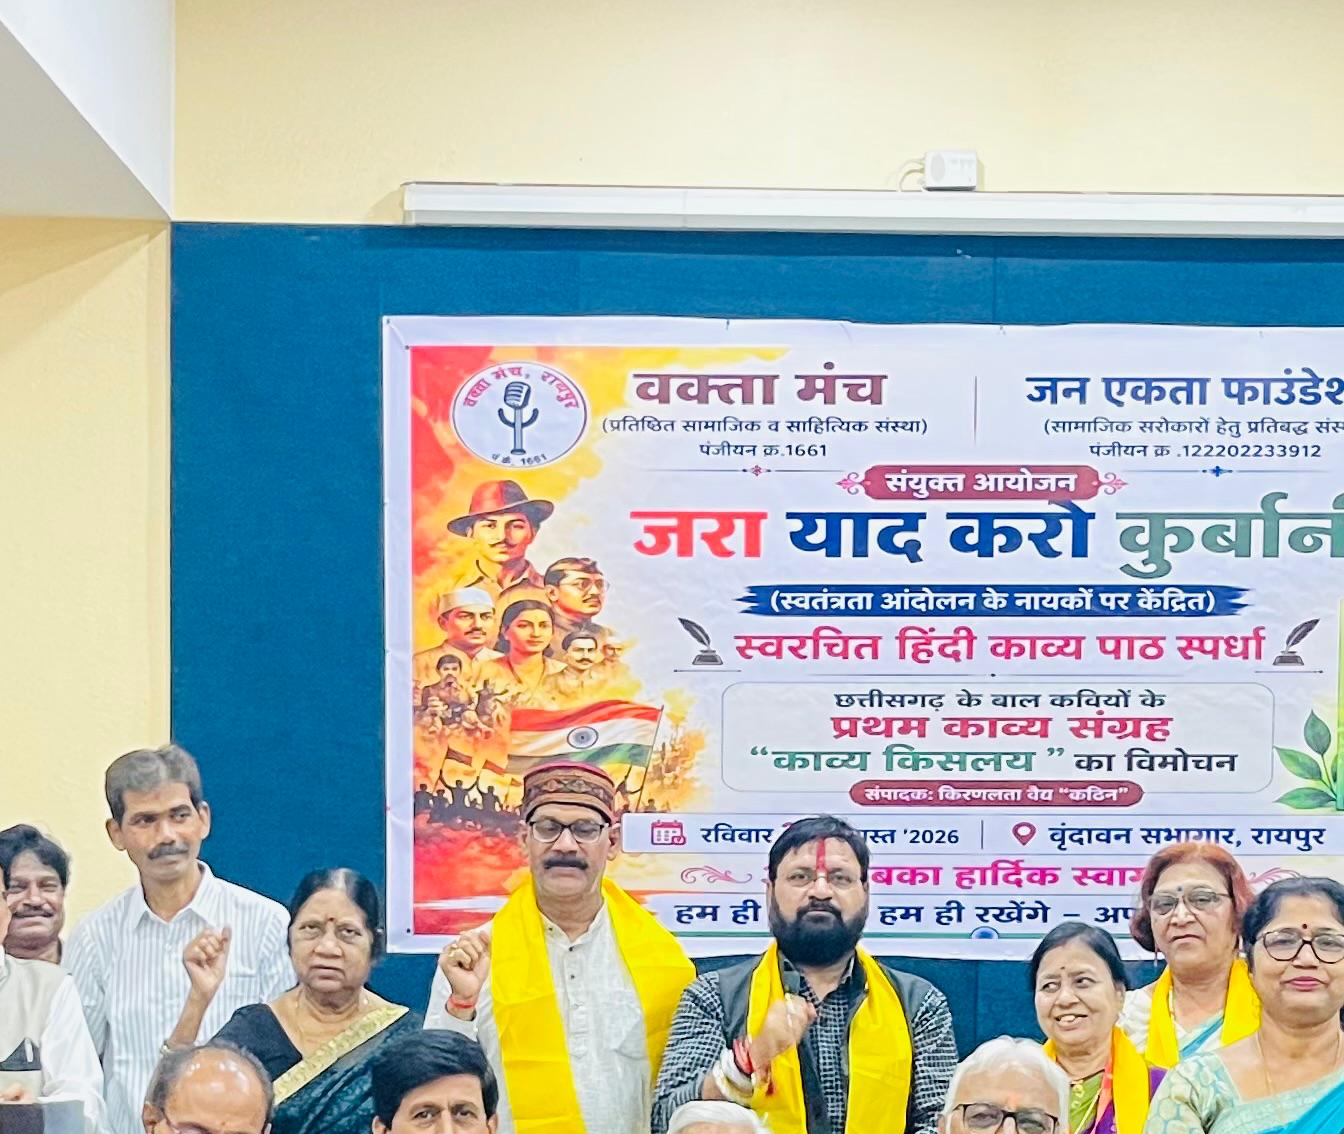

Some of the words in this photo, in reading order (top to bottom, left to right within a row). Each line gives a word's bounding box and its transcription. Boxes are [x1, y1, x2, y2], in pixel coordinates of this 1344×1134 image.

[633, 374, 779, 406] वक्ता
[795, 361, 888, 406] मंच
[1025, 377, 1090, 405] जन
[1102, 377, 1211, 407] एकता
[602, 415, 675, 434] (प्रतिष्ठित
[682, 416, 761, 433] सामाजिक
[768, 420, 779, 432] व
[786, 416, 868, 435] साहित्यिक
[875, 416, 928, 435] संस्था)
[1044, 417, 1132, 434] (सामाजिक
[1139, 416, 1209, 433] सरोकारों
[1216, 417, 1242, 438] हेतु
[1248, 418, 1309, 435] प्रतिबद्ध
[699, 440, 756, 456] पंजीयन
[1090, 441, 1147, 457] पंजीयन
[885, 469, 965, 498] संयुक्त
[973, 468, 1077, 492] आयोजन
[630, 511, 768, 558] जरा
[786, 511, 927, 565] याद
[946, 500, 1096, 558] करो
[771, 588, 873, 613] (स्वतंत्रता
[880, 588, 976, 612] आंदोलन
[982, 587, 1008, 610] के
[1015, 587, 1093, 610] नायकों
[1100, 592, 1133, 611] पर
[1137, 587, 1216, 613] केंद्रित)
[733, 625, 883, 660] स्वरचित
[895, 626, 977, 664] हिंदी
[988, 635, 1086, 660] काव्य
[1096, 635, 1166, 660] पाठ
[1176, 626, 1265, 660] स्पर्धा
[834, 689, 945, 711] छत्तीसगढ़
[955, 689, 983, 708] के
[1050, 689, 1133, 708] कवियों
[1139, 689, 1167, 708] के
[830, 717, 930, 739] प्रथम
[942, 717, 1053, 738] काव्य
[1067, 709, 1174, 742] संग्रह
[883, 743, 1037, 772] किसलय
[1074, 753, 1116, 772] का
[1124, 747, 1239, 772] विमोचन
[938, 784, 1022, 802] किरणलता
[700, 822, 774, 843] रविवार
[1048, 822, 1133, 851] वृंदावन
[1251, 827, 1326, 852] रायपुर
[869, 867, 943, 886] बका
[952, 859, 1062, 889] हार्दिक
[674, 905, 720, 924] हम
[730, 899, 762, 924] ही
[878, 906, 924, 925] हम
[934, 900, 965, 925] ही
[976, 900, 1051, 923] रखेंगे
